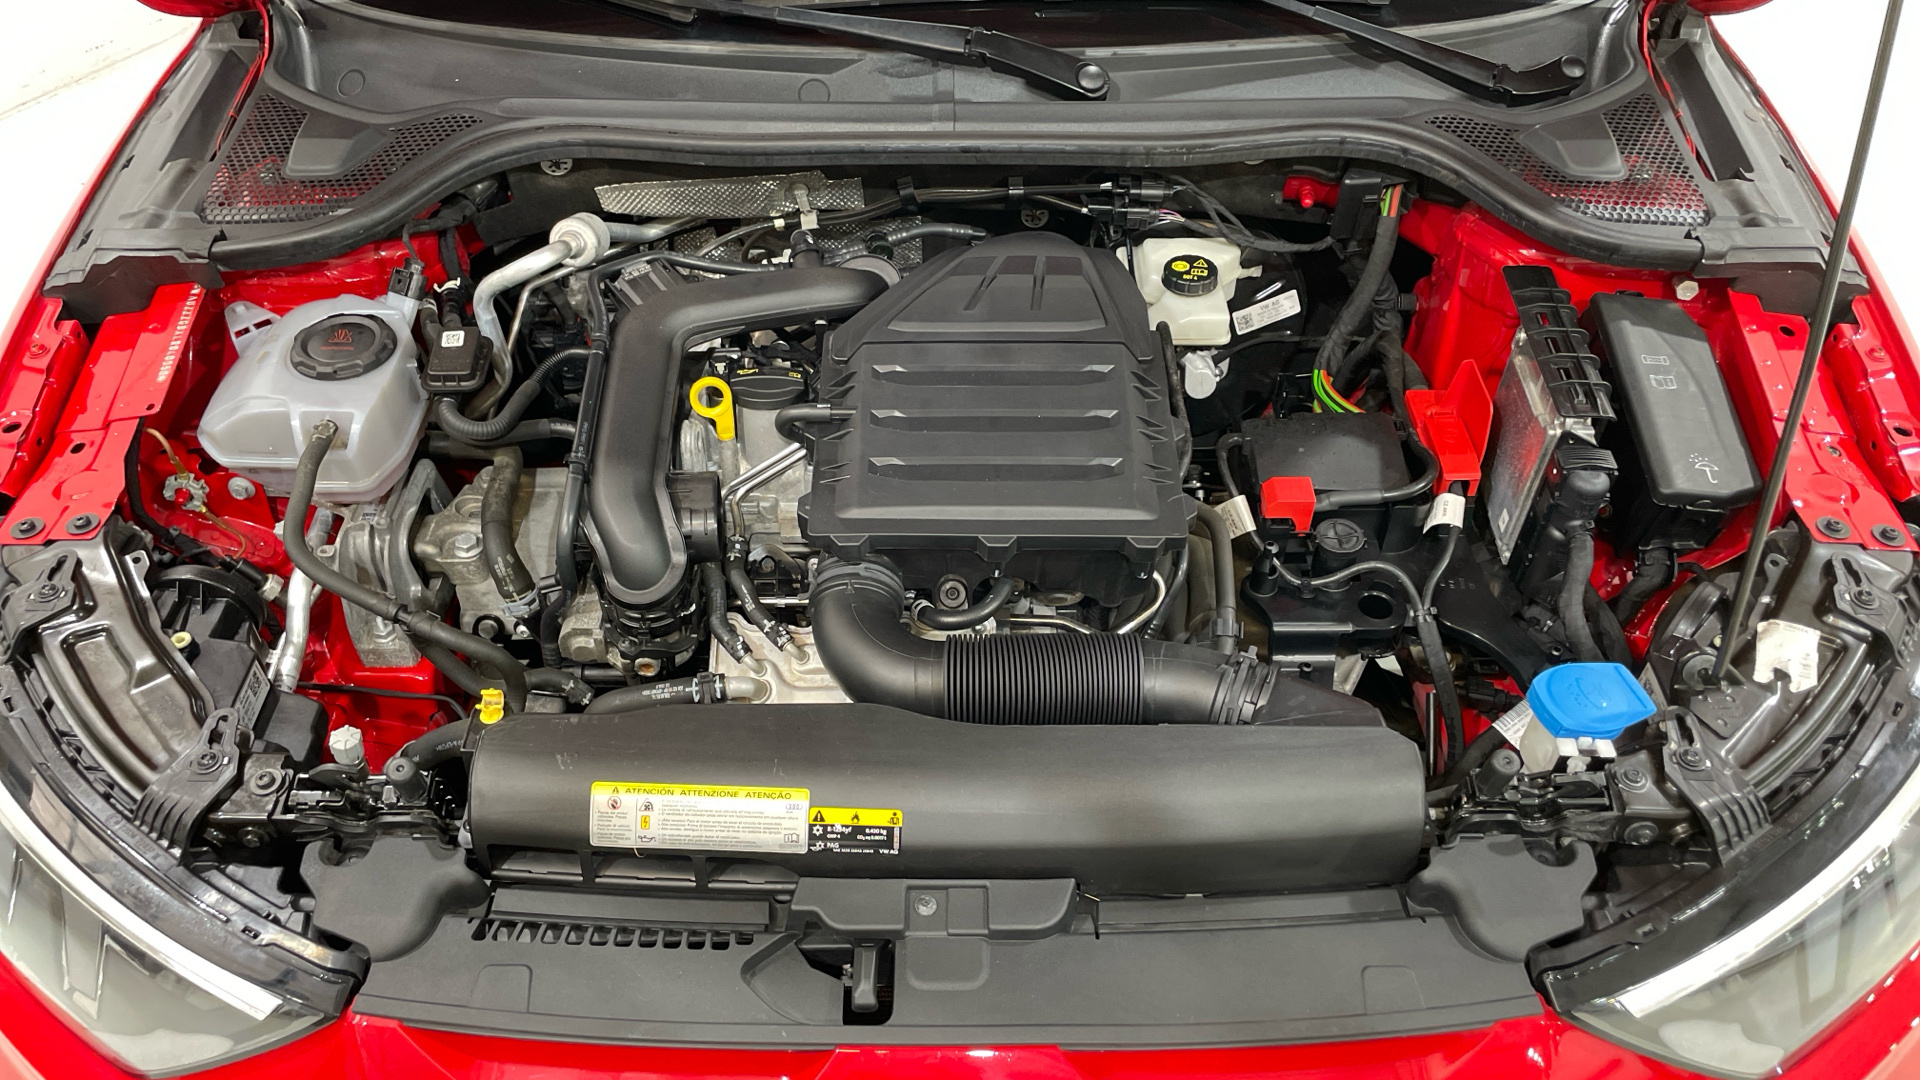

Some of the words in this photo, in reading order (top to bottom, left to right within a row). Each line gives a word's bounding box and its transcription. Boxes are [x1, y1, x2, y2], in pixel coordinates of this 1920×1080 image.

[1259, 303, 1270, 311] VW
[625, 787, 674, 796] ATENCIÓN
[679, 789, 739, 798] ATTENZIONE
